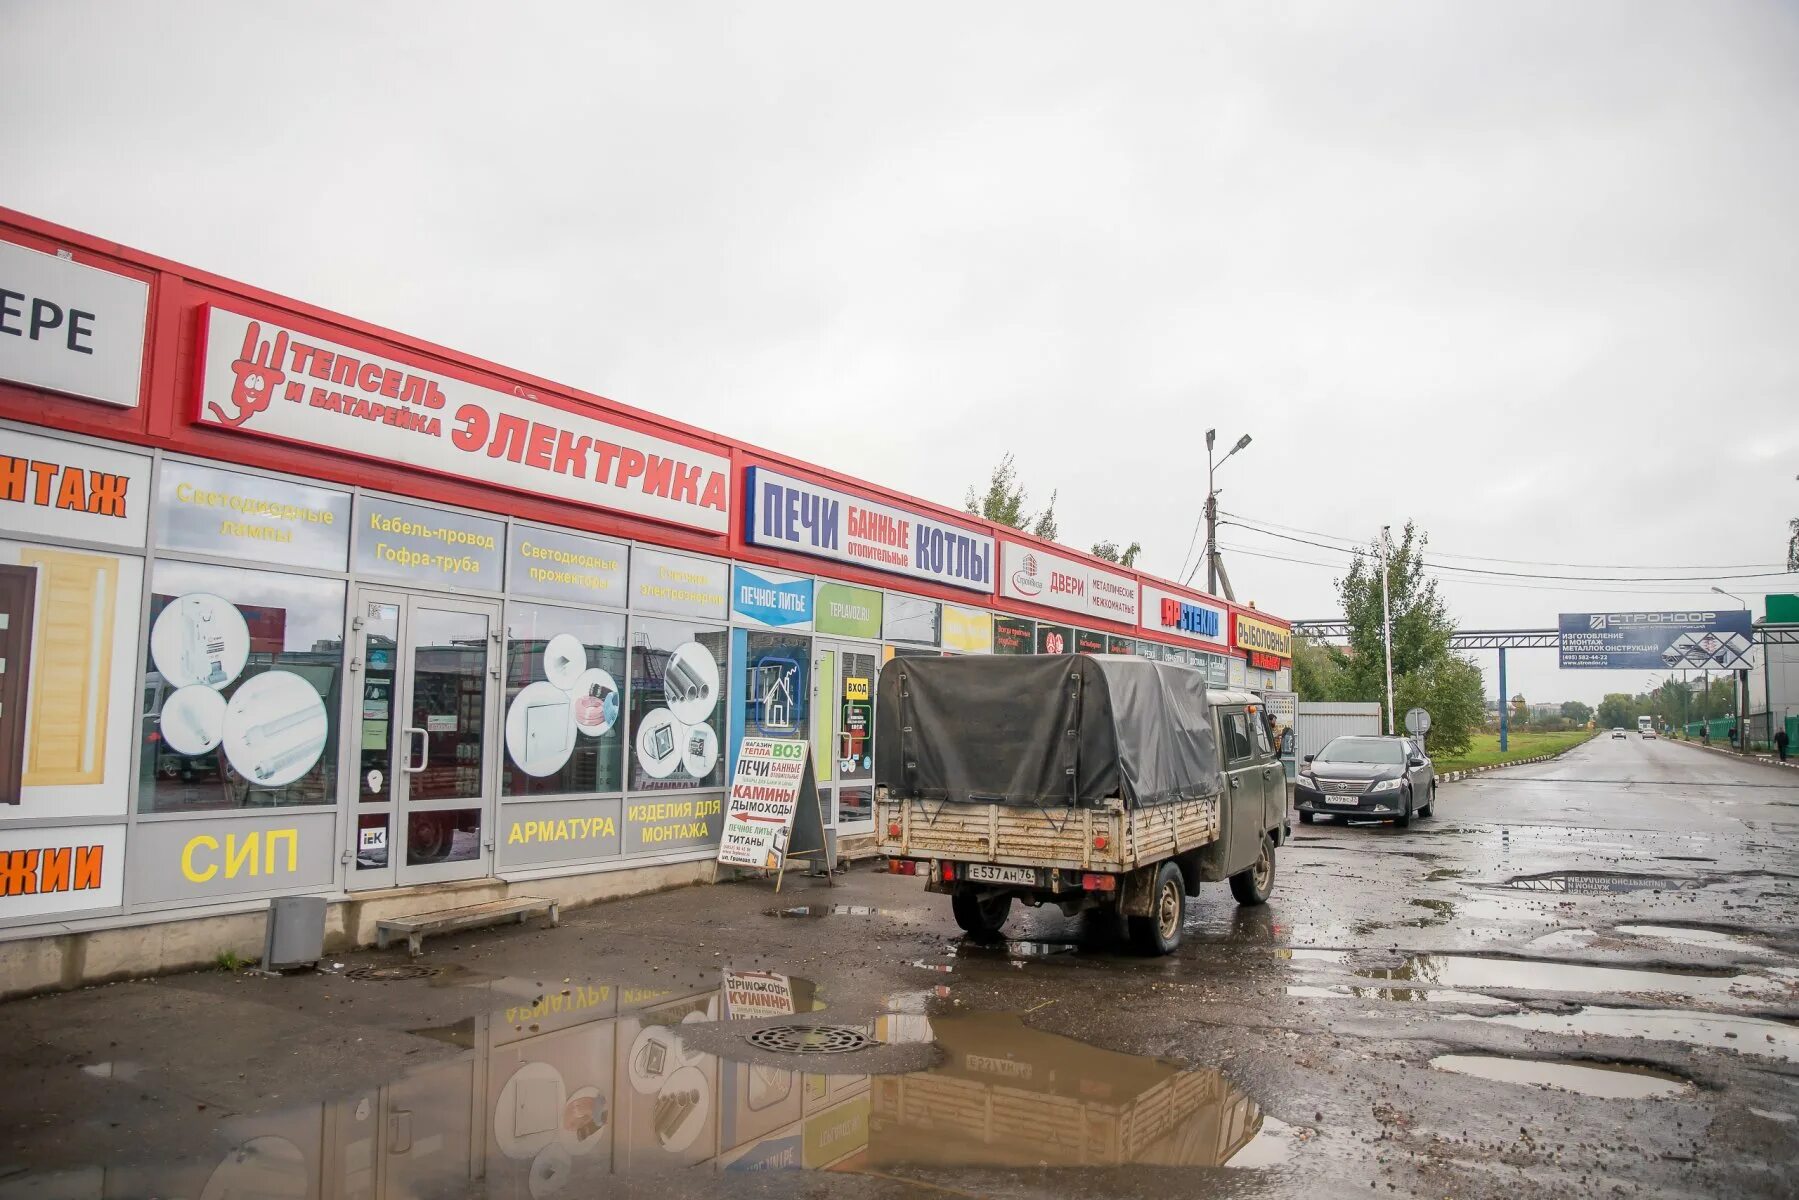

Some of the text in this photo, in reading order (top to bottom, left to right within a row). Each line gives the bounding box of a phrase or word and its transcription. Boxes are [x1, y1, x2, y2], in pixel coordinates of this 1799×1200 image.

[0, 288, 95, 355] ЕРЕ
[284, 380, 441, 437] И БАТАРЕЙКА
[451, 403, 726, 512] ЭЛЕКТРИКА
[0, 454, 130, 518] НТАЖ
[176, 482, 335, 526] Светодиодные
[763, 482, 839, 550] ПЕЧИ
[219, 520, 294, 544] лампы
[370, 513, 495, 551] Кабель-провод
[847, 505, 909, 550] БАННЫЕ
[376, 543, 480, 576] Гофра-труба
[521, 542, 619, 572] Светодиодные
[915, 523, 990, 584] КОТЛЫ
[529, 565, 609, 590] прожекторы
[1050, 571, 1084, 597] ДВЕРИ
[1092, 579, 1134, 599] МЕТАЛЛИЧЕСКИЕ
[741, 585, 806, 612] ПЕЧНОЕ ЛИТЬЕ
[1092, 596, 1135, 615] МЕЖКОМНАТНЫЕ
[830, 602, 870, 622] TEPLAVOZ.RU
[1607, 612, 1717, 623] СТРОНДОР
[1238, 622, 1290, 654] РЫБОЛОВНЫЙ
[1562, 632, 1624, 640] ИЗГОТОВЛЕНИЕ
[1562, 643, 1659, 652] МЕТАЛЛОКОНСТРУКЦИЙ
[848, 683, 867, 695] ВХОД
[744, 747, 771, 757] ТЕПЛА
[772, 743, 802, 759] ВОЗ
[737, 759, 802, 777] ПЕЧИ БАННЫЕ
[732, 784, 796, 803] КАМИНЫ
[628, 800, 721, 822] ИЗДЕЛИЯ ДЛЯ
[730, 800, 793, 816] ДЫМОХОДЫ
[508, 817, 615, 845] АРМАТУРА
[642, 822, 709, 843] МОНТАЖА
[727, 834, 765, 847] ТИТАНЫ
[728, 823, 774, 836] ПЕЧНОЕ ЛИТЬЕ
[181, 828, 298, 883] СИП
[0, 845, 104, 897] ЖИИ
